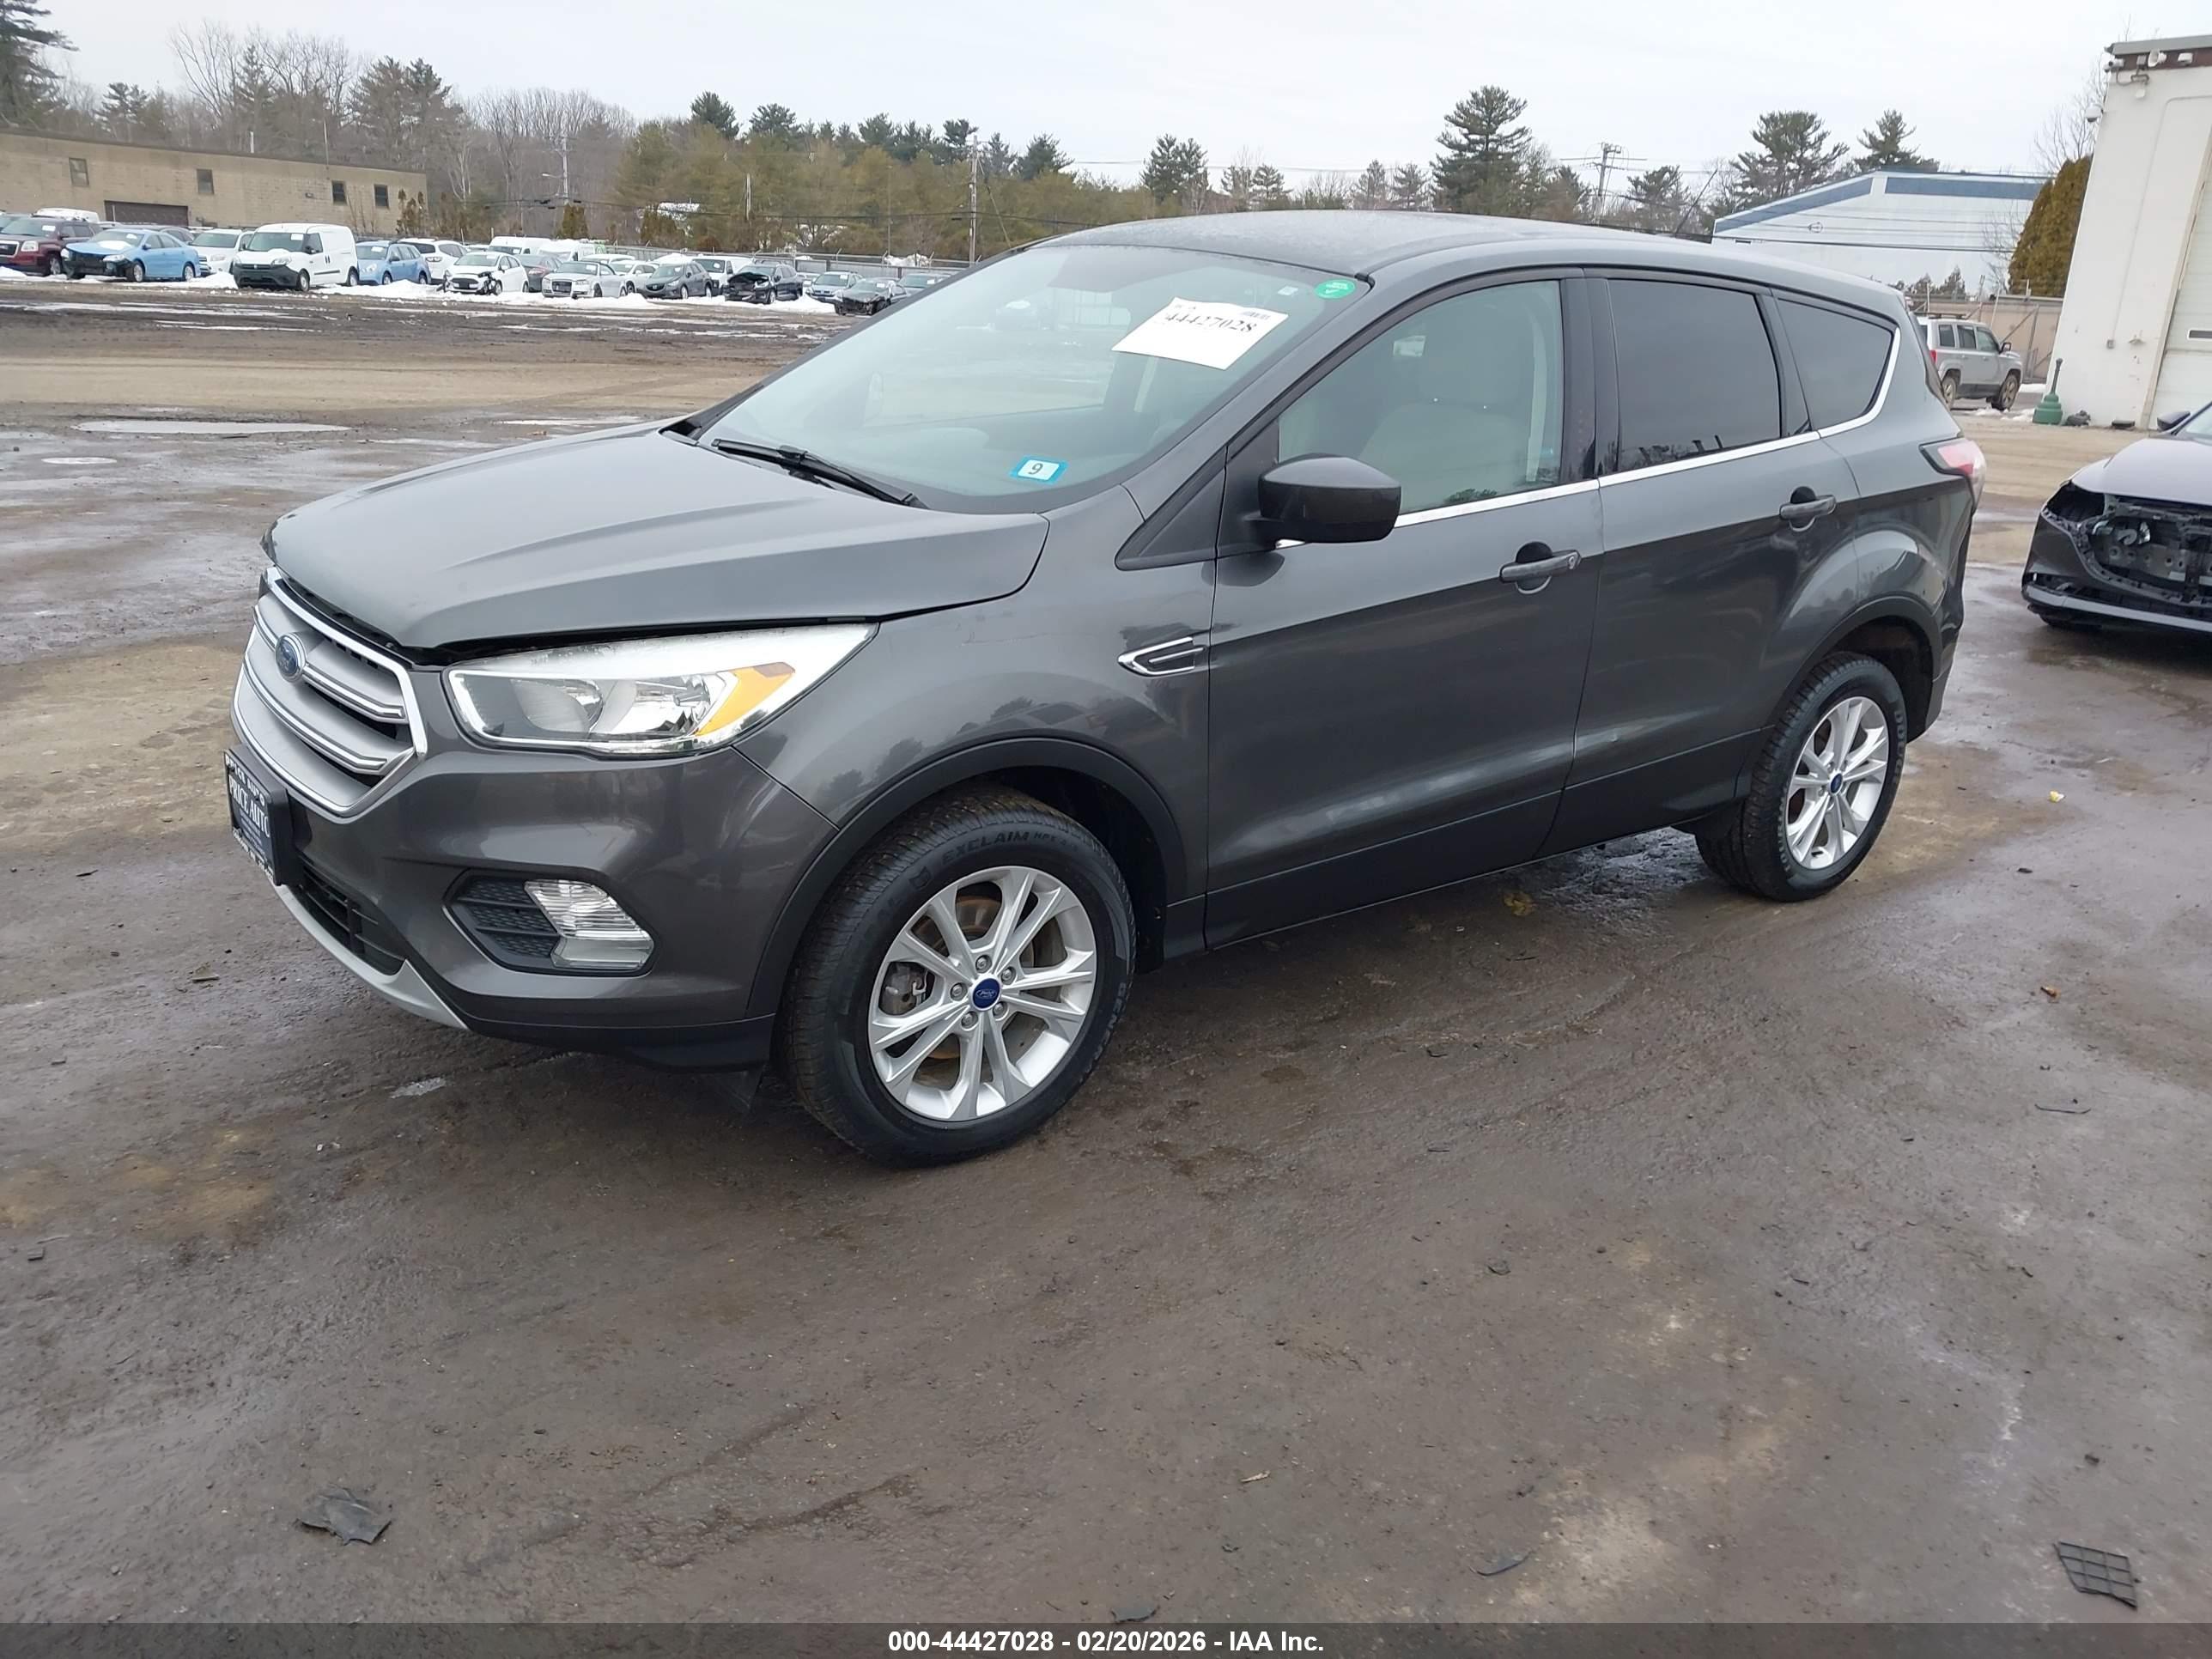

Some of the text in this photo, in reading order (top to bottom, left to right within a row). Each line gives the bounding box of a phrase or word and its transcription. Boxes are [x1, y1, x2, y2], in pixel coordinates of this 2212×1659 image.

[1028, 462, 1044, 476] 9
[228, 774, 249, 815] PRICE
[943, 830, 1030, 862] EXCLAIM
